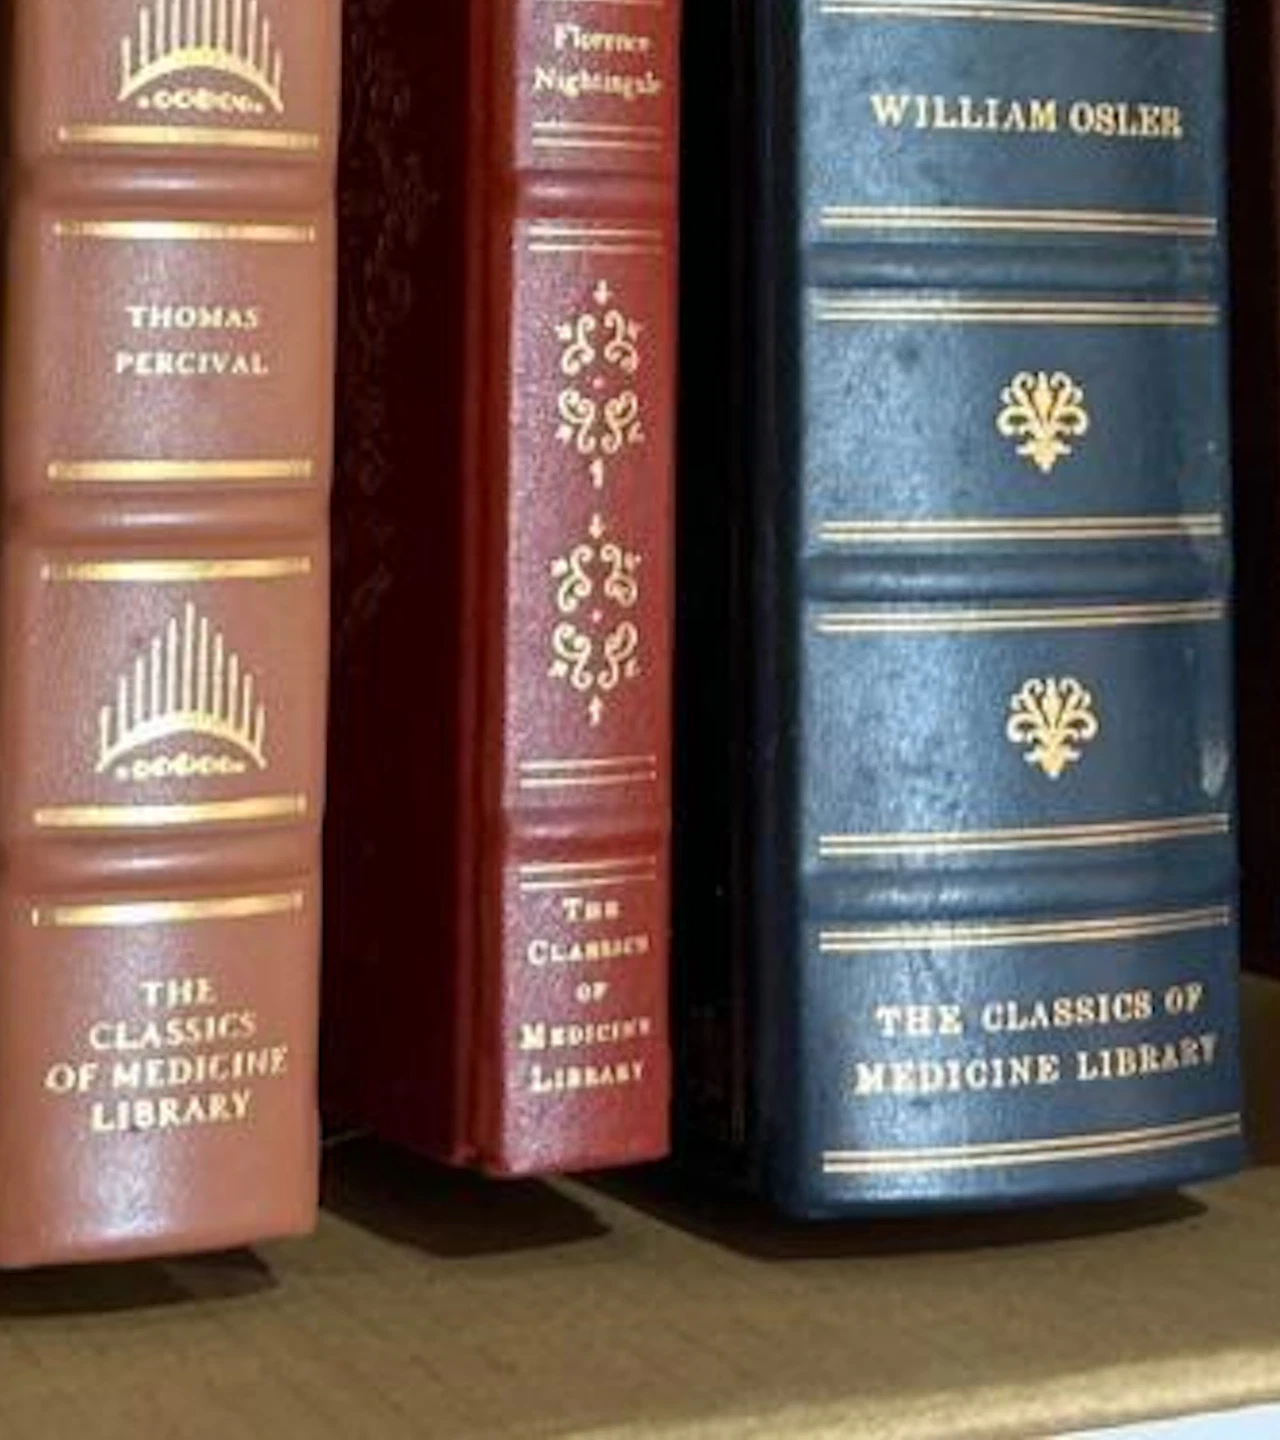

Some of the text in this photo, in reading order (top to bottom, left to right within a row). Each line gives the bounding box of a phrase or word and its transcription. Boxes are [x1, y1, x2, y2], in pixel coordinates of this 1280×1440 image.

[871, 94, 1184, 140] WILLIAM OSLER
[126, 306, 260, 330] THOMAS
[115, 350, 269, 376] PERCIVAL
[140, 977, 217, 1008] THE
[875, 981, 1204, 1038] THE CLASSICS OF
[89, 1011, 256, 1050] CLASSICS
[44, 1046, 288, 1094] OF MEDICINE
[854, 1033, 1220, 1096] MEDICINE LIBRARY
[90, 1089, 251, 1132] LIBRARY
